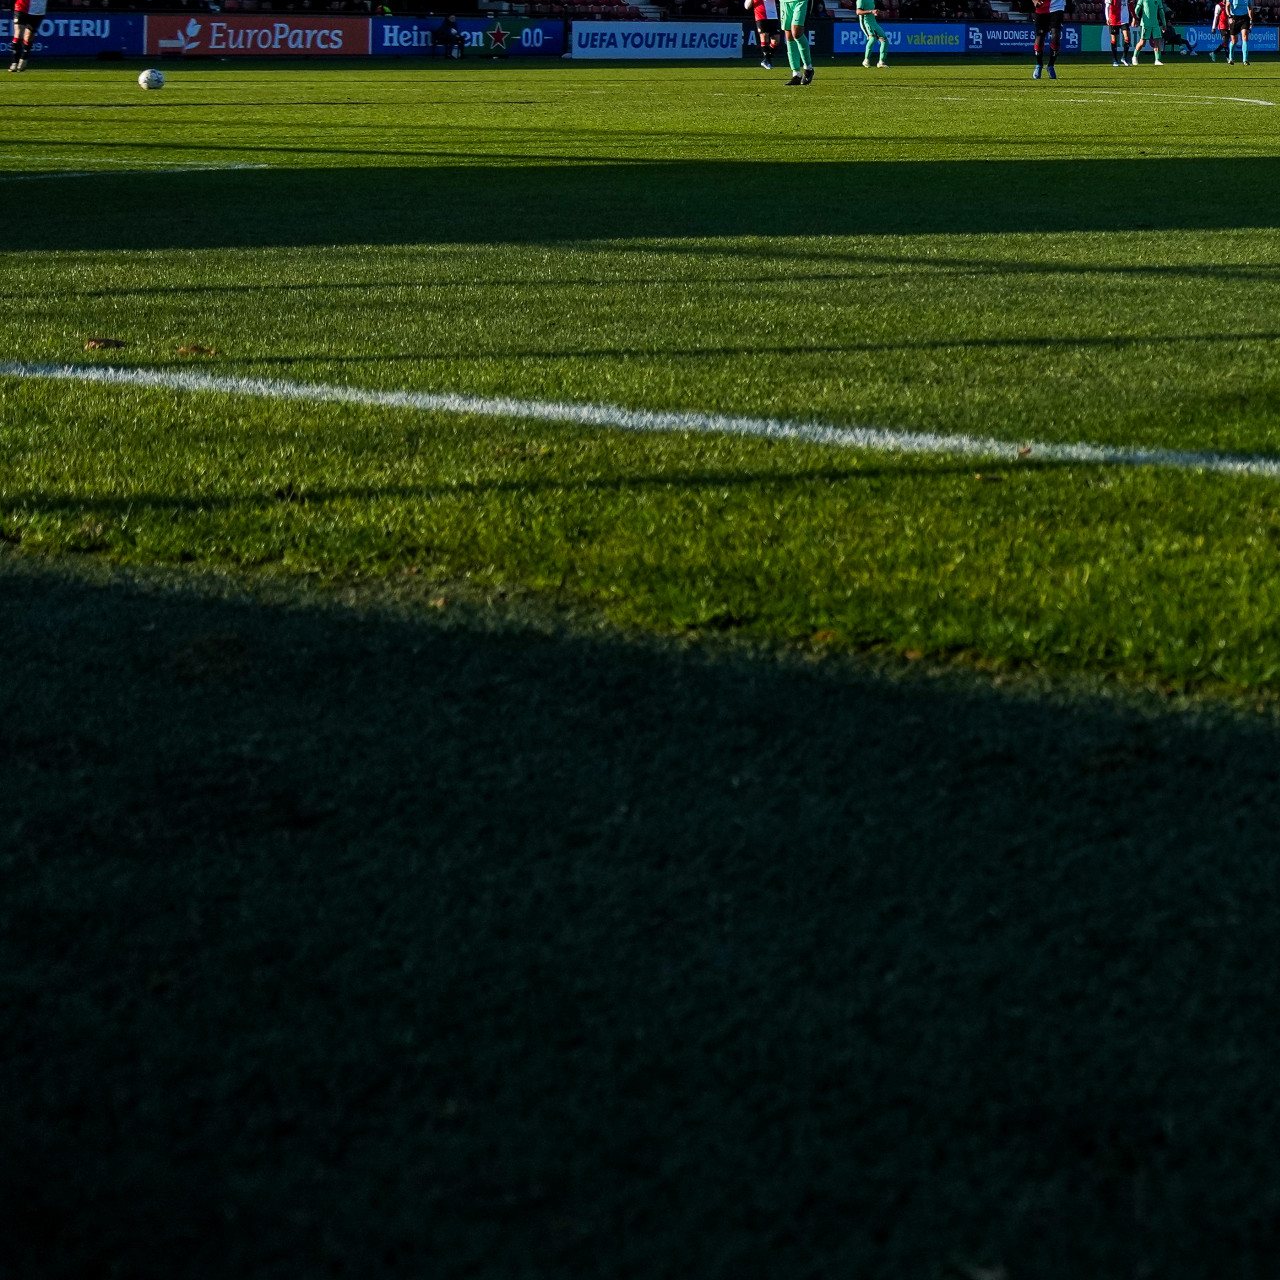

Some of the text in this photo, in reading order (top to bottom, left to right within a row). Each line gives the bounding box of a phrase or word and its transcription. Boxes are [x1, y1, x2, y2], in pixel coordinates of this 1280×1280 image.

[0, 19, 111, 39] EOTERIJ
[208, 22, 343, 49] EuroParcs
[383, 25, 484, 47] Heinen
[986, 30, 1001, 40] VAN
[1003, 30, 1029, 40] DONGE
[1198, 30, 1225, 42] Hoogv
[1247, 30, 1277, 42] oogvliet
[577, 32, 617, 49] UEFA
[621, 32, 677, 49] YOUTH
[681, 32, 739, 49] LEAGUE
[906, 32, 960, 45] vakanties
